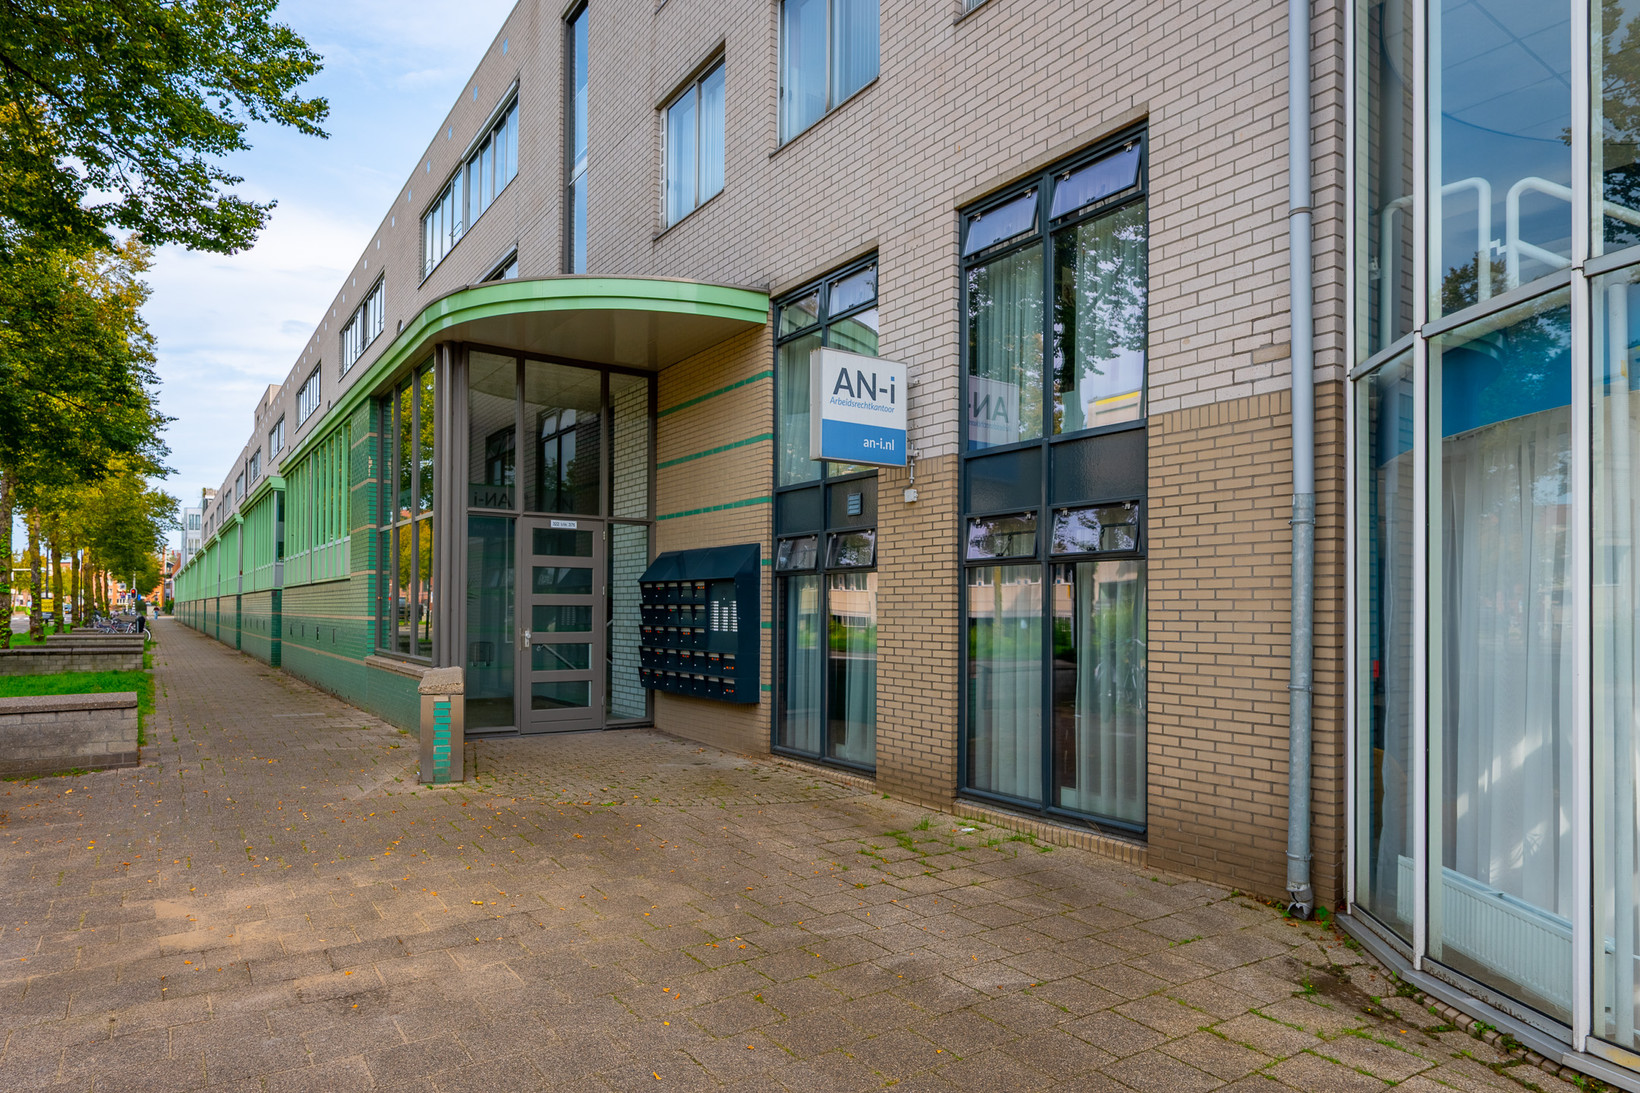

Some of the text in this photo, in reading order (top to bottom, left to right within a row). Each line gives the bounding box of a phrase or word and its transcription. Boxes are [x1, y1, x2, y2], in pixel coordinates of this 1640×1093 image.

[833, 367, 895, 404] AN-i
[830, 396, 895, 413] Arbeidsrechtkantoor
[863, 438, 895, 451] an-i.nl
